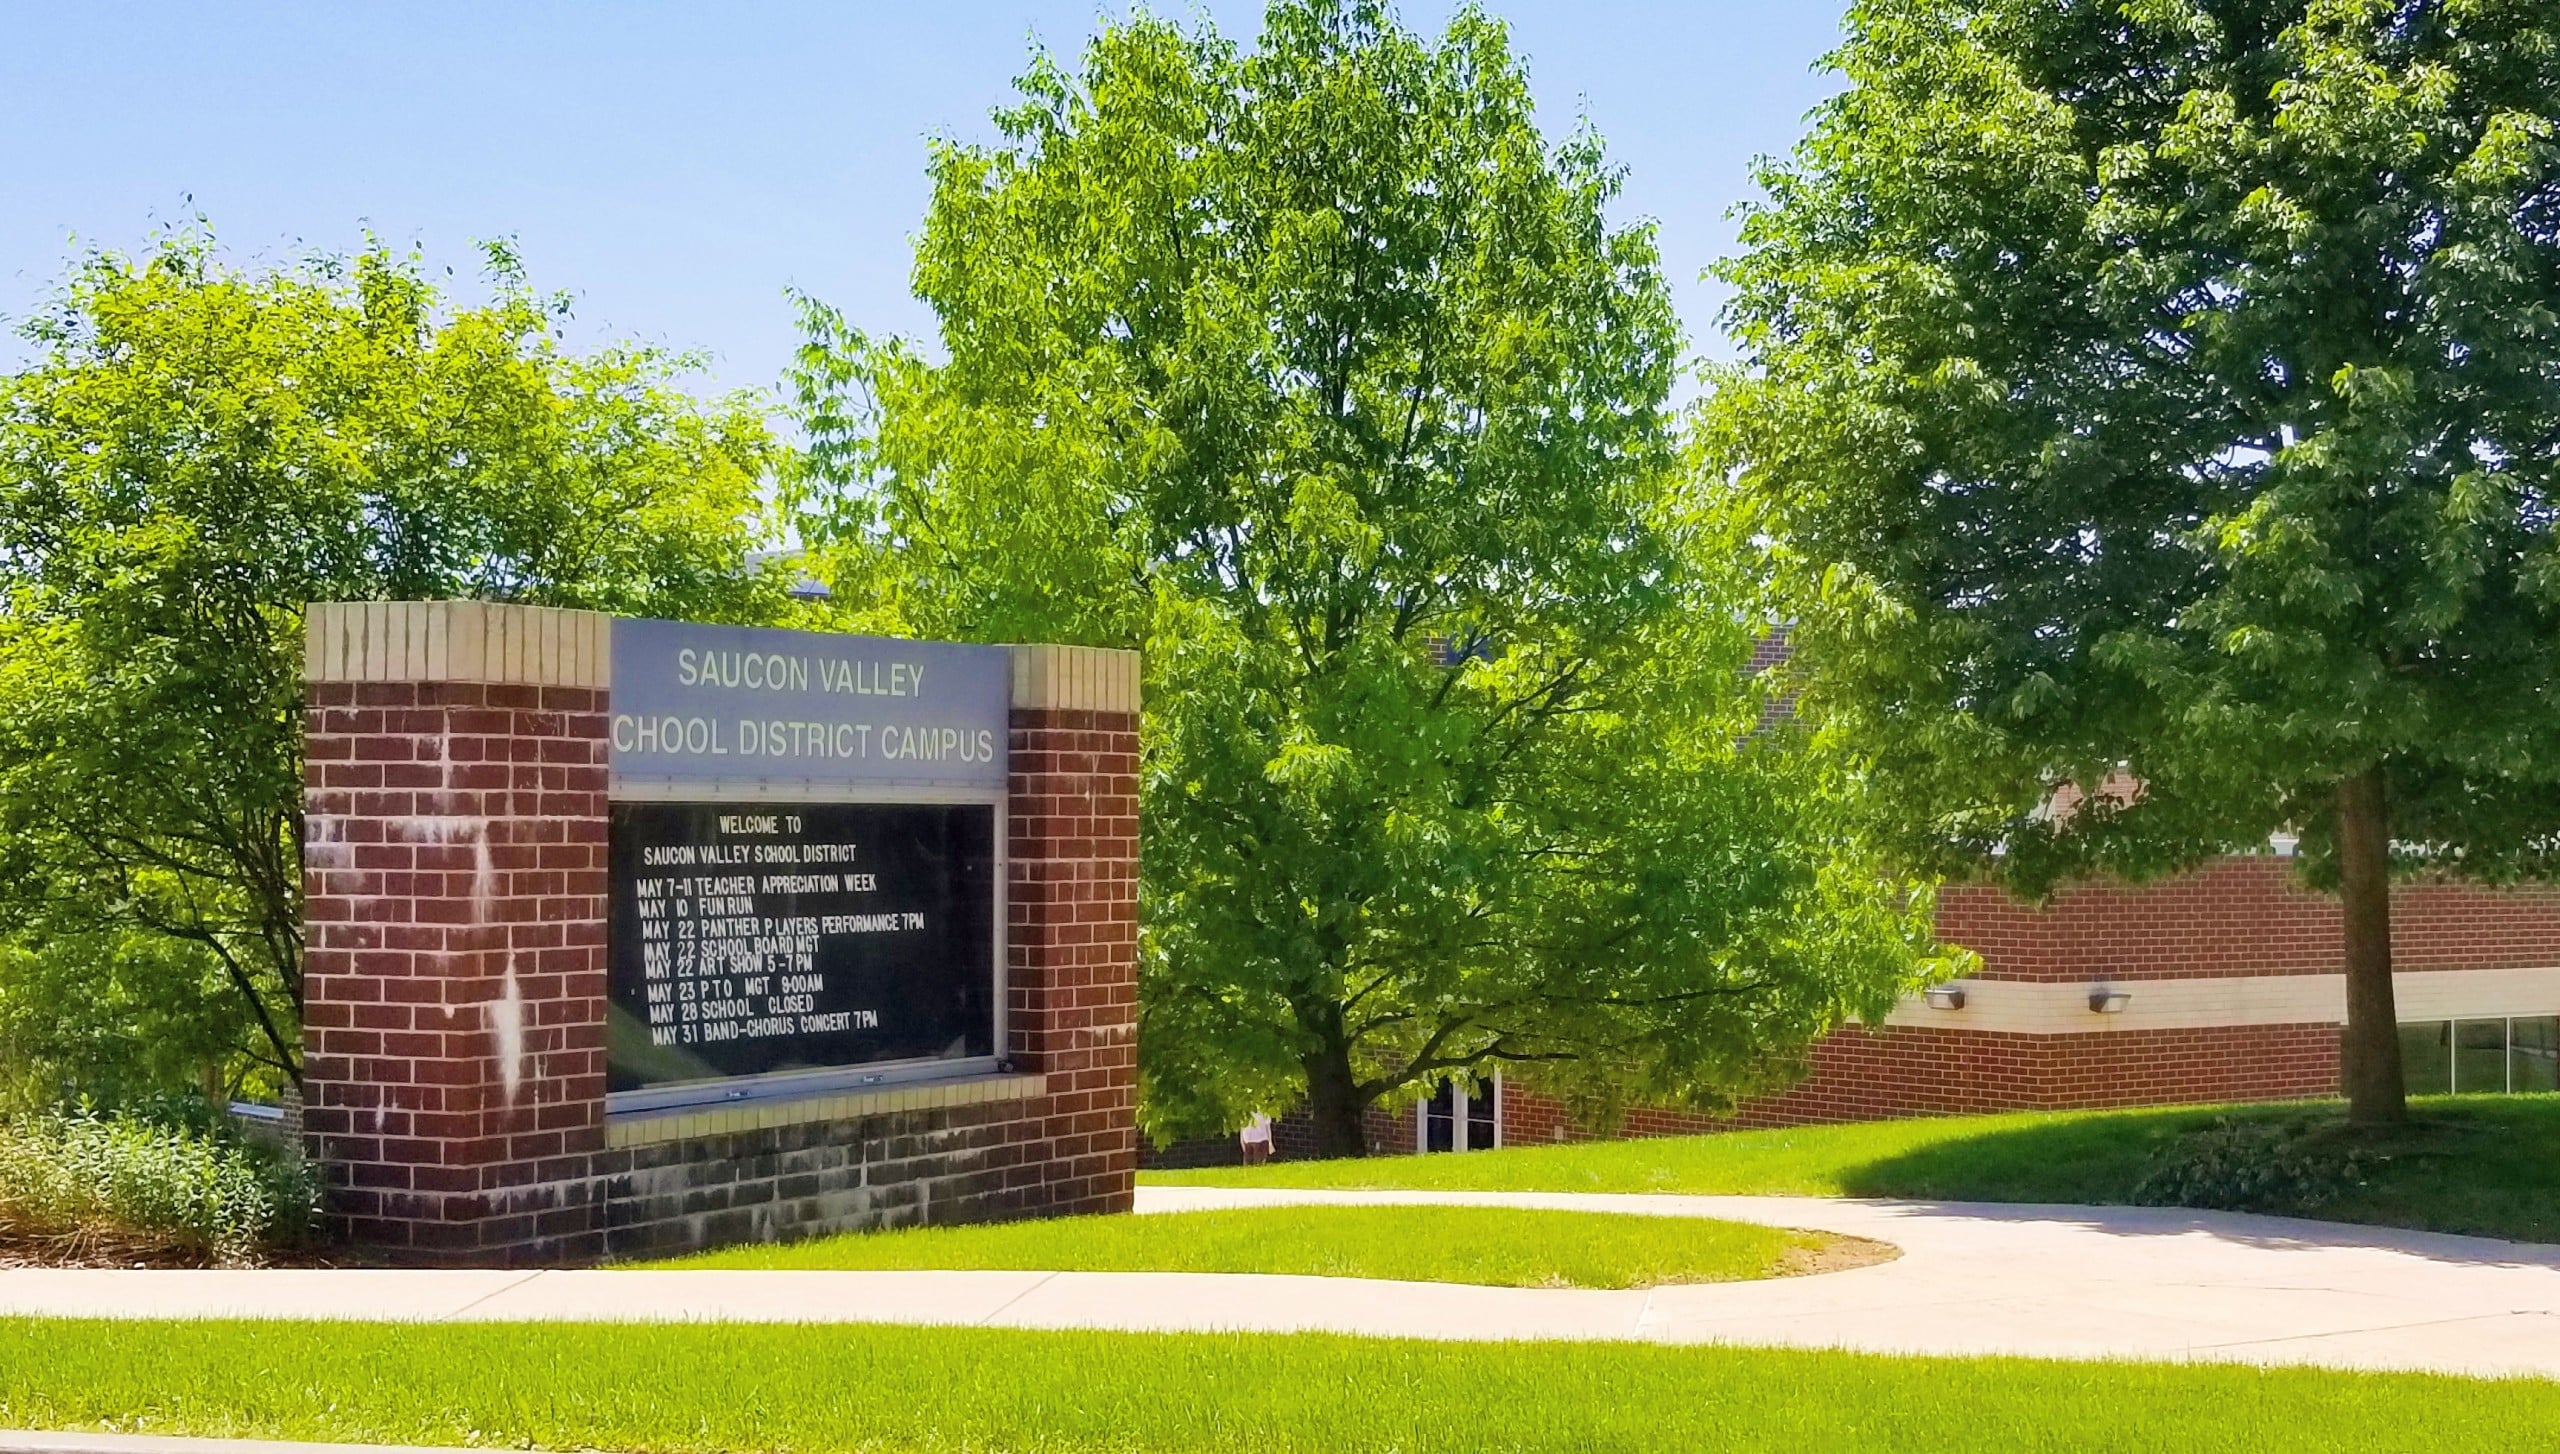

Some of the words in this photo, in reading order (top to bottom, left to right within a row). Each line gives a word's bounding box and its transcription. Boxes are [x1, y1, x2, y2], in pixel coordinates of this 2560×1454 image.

[679, 648, 809, 692] SAUCON
[819, 658, 925, 698] VALLEY
[612, 714, 729, 755] CHOOL
[740, 720, 872, 757] DISTRICT
[881, 725, 993, 763] CAMPUS
[719, 815, 779, 834] WELCOME
[786, 815, 802, 833] TO
[644, 846, 695, 866] SAUCON
[700, 845, 750, 864] VALLEY
[754, 844, 800, 863] SCHOOL
[804, 844, 856, 862] DISTRICT
[636, 878, 663, 898] MAY
[666, 877, 693, 897] 7-11
[695, 875, 755, 896] TEACHER
[762, 874, 839, 895] APPRECIATION
[845, 873, 877, 893] WEEK
[638, 898, 666, 919] MAY
[676, 898, 688, 918] 10
[700, 897, 727, 917] FUN
[728, 896, 754, 915] RUN
[642, 920, 670, 940] MAY
[678, 920, 696, 939] 22
[701, 917, 760, 938] PANTHER
[764, 916, 819, 936] PLAYERS
[822, 913, 900, 934] PERFORMANCE
[644, 941, 671, 960] MAY
[677, 941, 696, 960] 22
[700, 938, 753, 958] SCHOOL
[754, 935, 794, 955] BOARD
[795, 934, 820, 953] MGT
[645, 959, 672, 979] MAY
[676, 958, 695, 978] 22
[699, 956, 725, 977] ART
[730, 954, 763, 974] SHOW
[647, 982, 672, 1003] MAY
[679, 981, 696, 1001] 23
[745, 976, 770, 996] MGT
[649, 1003, 675, 1024] MAY
[681, 1002, 699, 1021] 28
[702, 998, 755, 1020] SCHOOL
[768, 994, 814, 1014] CLOSED
[652, 1025, 677, 1046] MAY
[682, 1023, 698, 1043] 31
[704, 1016, 795, 1042] BAND-CHORUS
[801, 1011, 851, 1034] CONCERT
